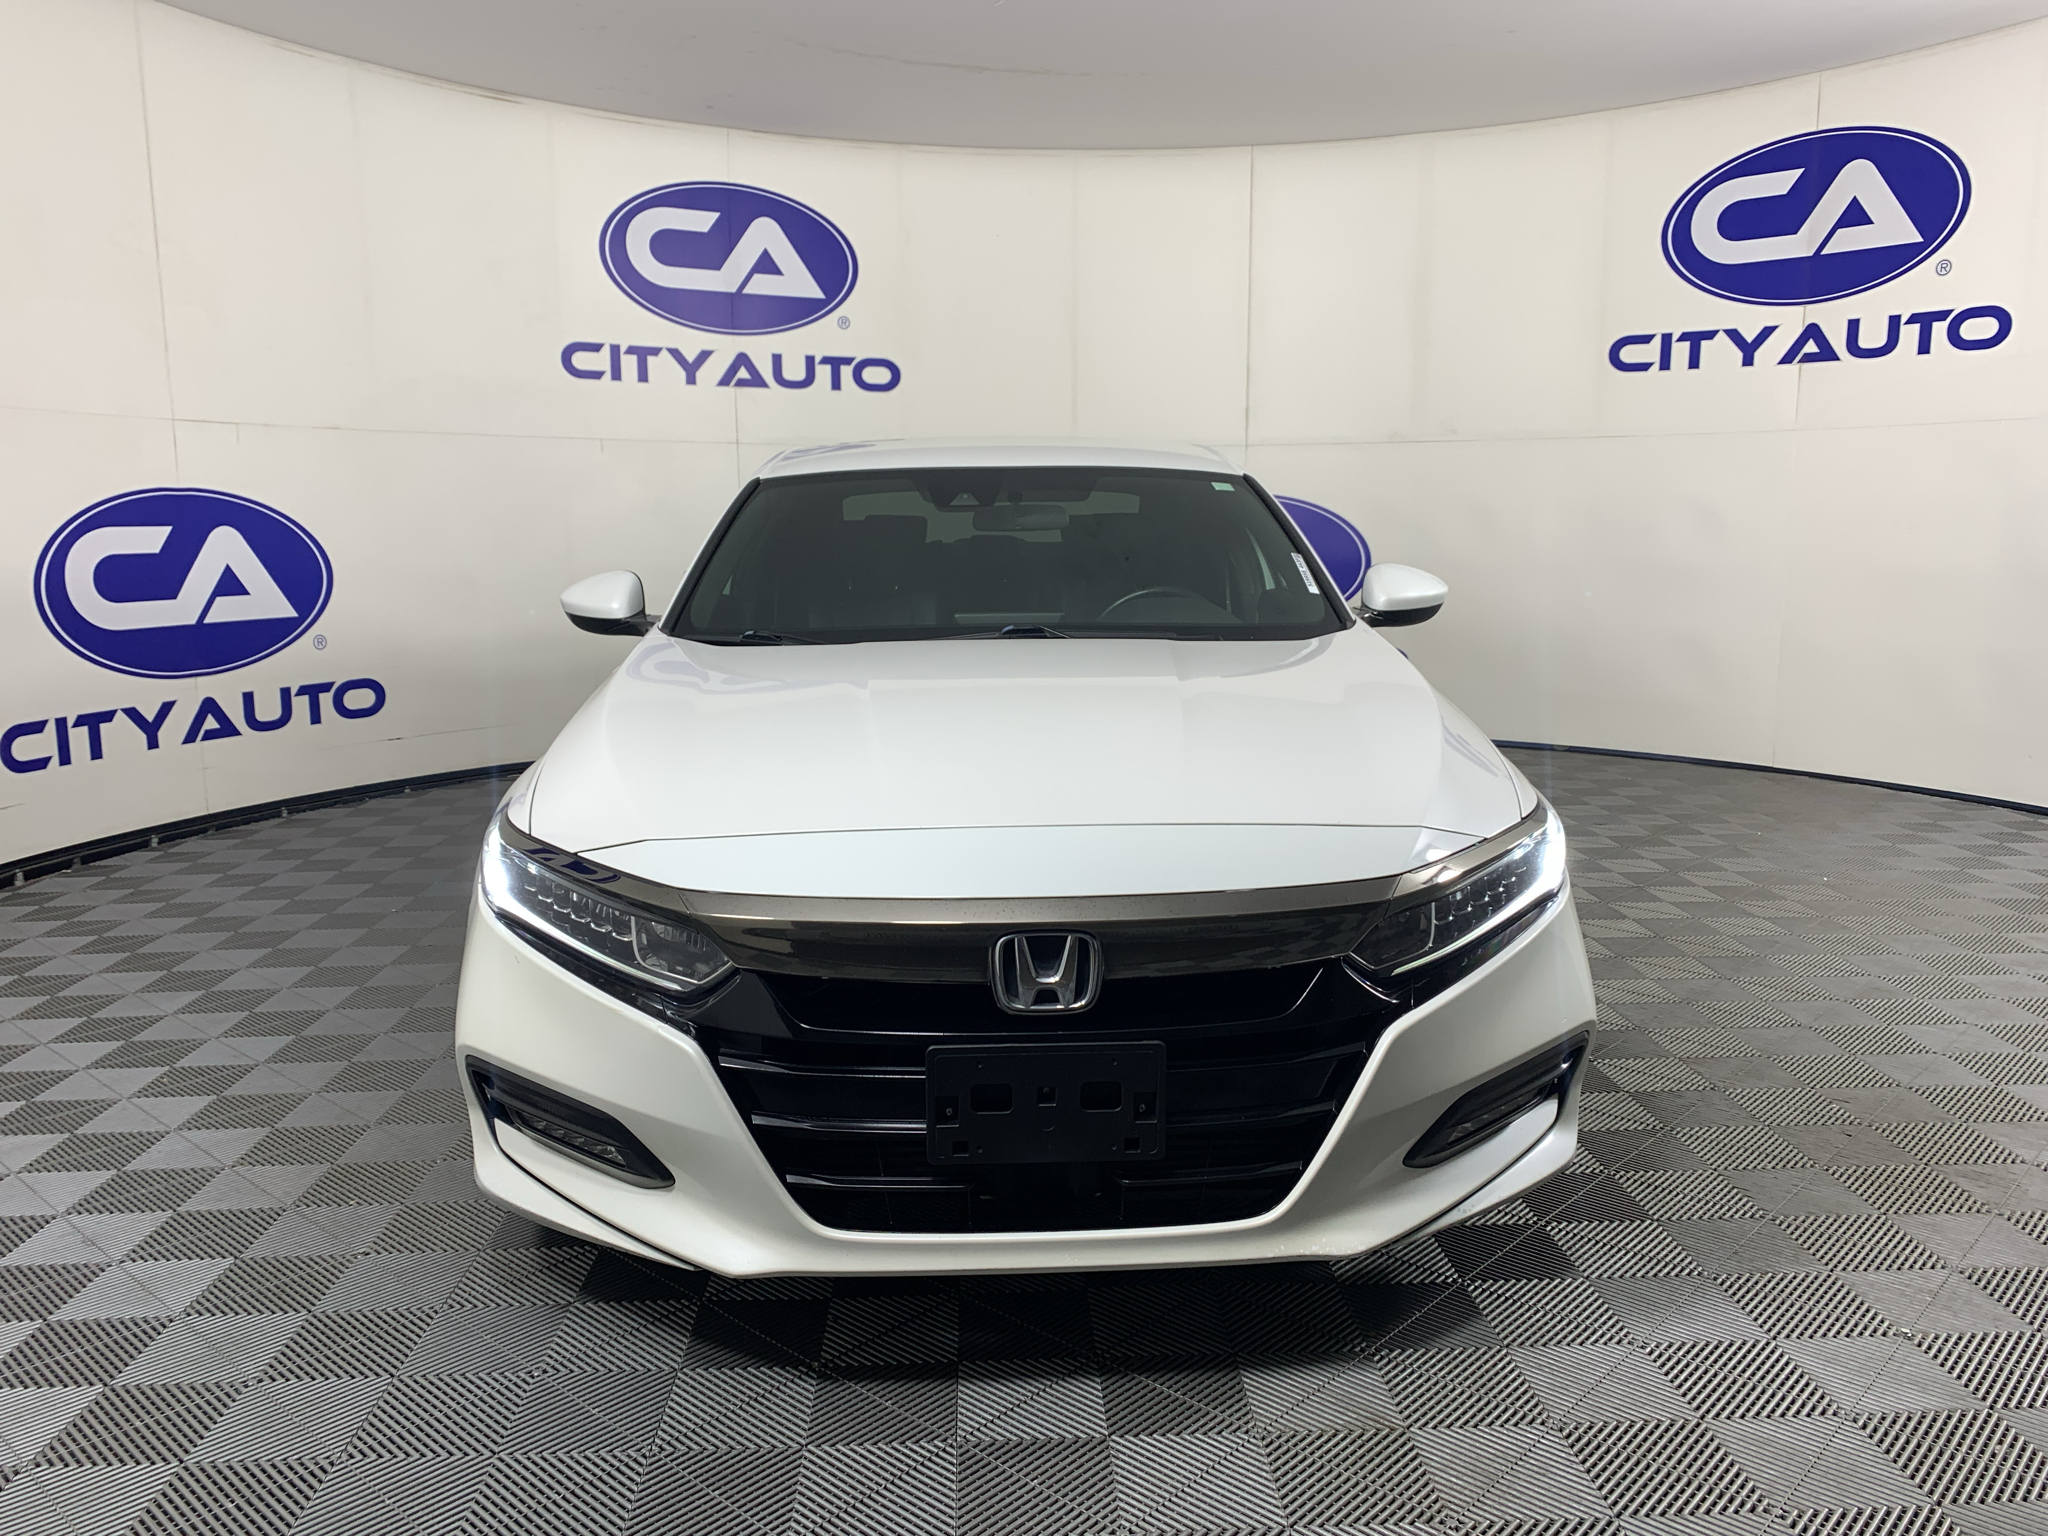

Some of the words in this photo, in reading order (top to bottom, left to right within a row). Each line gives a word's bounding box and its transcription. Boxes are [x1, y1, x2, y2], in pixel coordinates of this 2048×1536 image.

[625, 206, 827, 299] CA
[1690, 158, 1925, 265] CA
[560, 341, 716, 386] CITY
[716, 351, 902, 393] AUTO
[1608, 322, 1783, 372] CITY
[1776, 304, 2013, 366] AUTO
[64, 525, 299, 631] CA
[0, 699, 178, 774] CITY
[181, 678, 386, 746] AUTO
